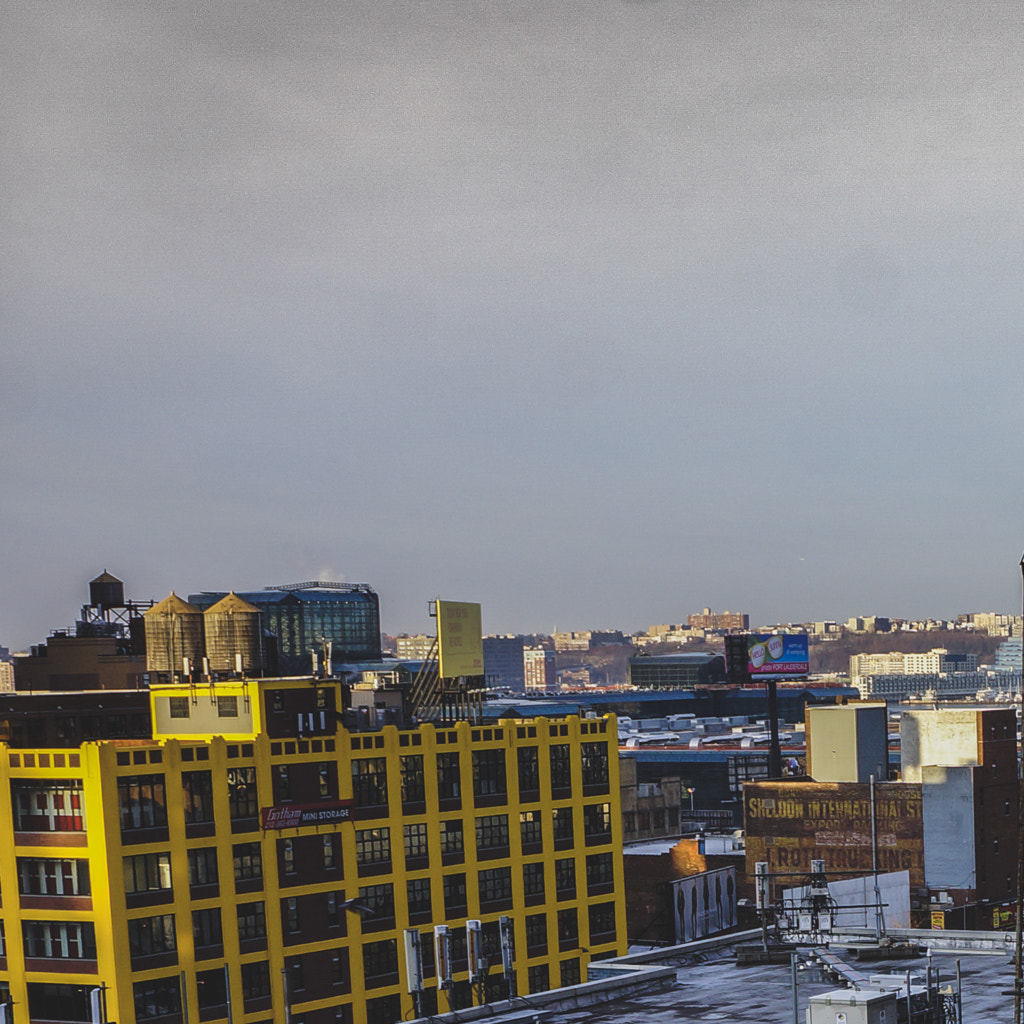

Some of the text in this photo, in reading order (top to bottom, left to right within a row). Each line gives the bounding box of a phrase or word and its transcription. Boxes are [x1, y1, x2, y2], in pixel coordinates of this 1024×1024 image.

[267, 807, 349, 820] Gotham MINI STORAGE
